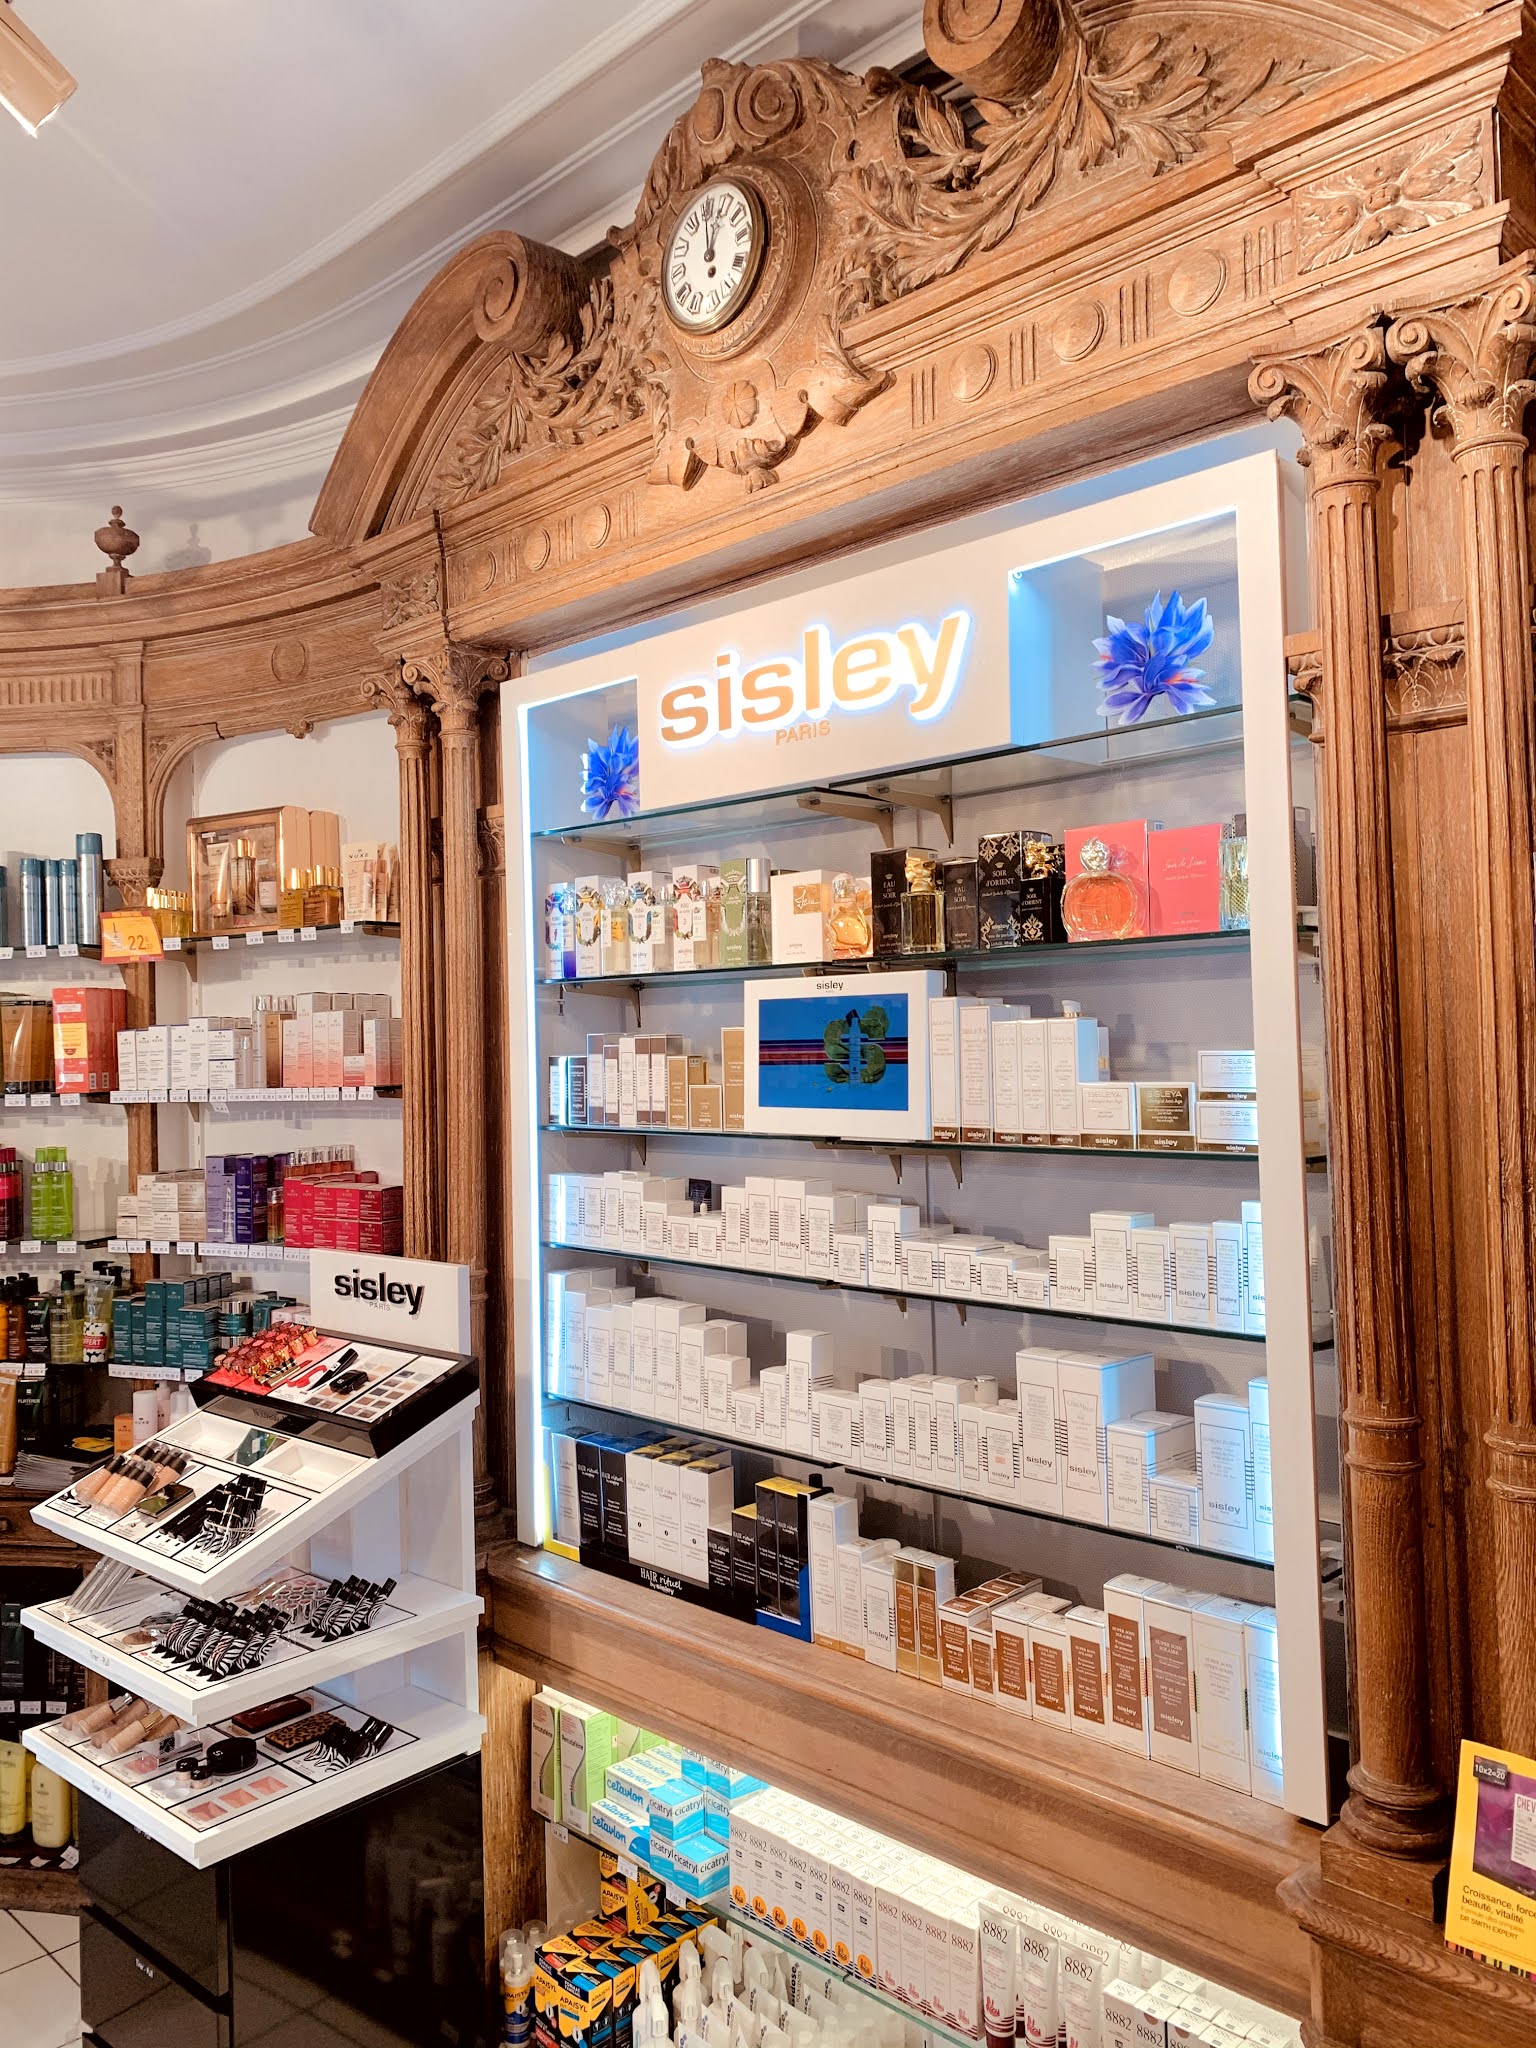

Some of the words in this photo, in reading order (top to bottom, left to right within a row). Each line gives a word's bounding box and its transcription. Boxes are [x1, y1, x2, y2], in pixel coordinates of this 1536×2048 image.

[660, 616, 961, 742] sisley
[775, 720, 831, 745] PARIS
[816, 981, 844, 990] sisley
[935, 1130, 956, 1138] sisley
[750, 1237, 769, 1245] sisley
[780, 1240, 799, 1249] sisley
[810, 1249, 828, 1258] sisley
[334, 1268, 425, 1315] sisley
[1060, 1284, 1082, 1293] sisley
[1100, 1281, 1124, 1291] sisley
[1178, 1289, 1207, 1299] sisley
[1140, 1292, 1163, 1300] sisley
[1219, 1296, 1237, 1304] sisley
[370, 1302, 390, 1312] PARIS
[827, 1439, 843, 1449] sisley
[865, 1442, 885, 1452] sisley
[1026, 1456, 1052, 1468] sisley
[1069, 1465, 1097, 1477] sisley
[1118, 1496, 1138, 1504] sisley
[1208, 1500, 1241, 1514] sisley
[1164, 1519, 1183, 1528] sisley
[640, 1568, 658, 1582] HAIR
[659, 1573, 683, 1590] rituel
[869, 1630, 888, 1641] sisley
[948, 1664, 964, 1673] sisley
[1003, 1681, 1020, 1690] sisley
[1041, 1693, 1059, 1703] sisley
[1079, 1704, 1098, 1715] sisley
[1117, 1705, 1136, 1716] sisley
[1160, 1713, 1184, 1726] sisley
[1475, 1764, 1505, 1780] 10x2=20
[607, 1779, 644, 1806] cetavlon
[598, 1800, 635, 1824] cetavlon
[650, 1799, 673, 1817] cicatryl
[674, 1797, 703, 1817] cicatryl
[708, 1798, 730, 1817] cicatry
[592, 1815, 626, 1844] cetavlon
[730, 1826, 747, 1842] 8882
[651, 1839, 674, 1859] cicatryl
[750, 1835, 767, 1852] 8882
[769, 1845, 788, 1862] 8882
[674, 1852, 698, 1873] cicatryl
[700, 1852, 729, 1873] cicatryl
[789, 1856, 807, 1873] 8882
[810, 1867, 828, 1885] 8882
[831, 1876, 850, 1896] 8882
[602, 1889, 625, 1904] APAISYL
[853, 1889, 873, 1908] 8882
[1463, 1885, 1514, 1911] Croissance,
[878, 1900, 898, 1920] 8882
[1496, 1909, 1523, 1924] vitalité
[902, 1910, 923, 1931] 8882
[1460, 1914, 1470, 1922] DR
[1471, 1918, 1491, 1930] SMITH
[1492, 1926, 1518, 1940] EXPERT
[926, 1923, 947, 1944] 8882
[983, 1920, 1009, 1945] 8882
[951, 1934, 974, 1954] 8882
[1023, 1937, 1050, 1962] 8882
[1064, 1956, 1093, 1982] 8882
[535, 1975, 557, 1993] APAISYL
[560, 1995, 588, 2013] APAISYL
[1105, 2008, 1132, 2031] 8882
[1136, 2023, 1163, 2047] 8882
